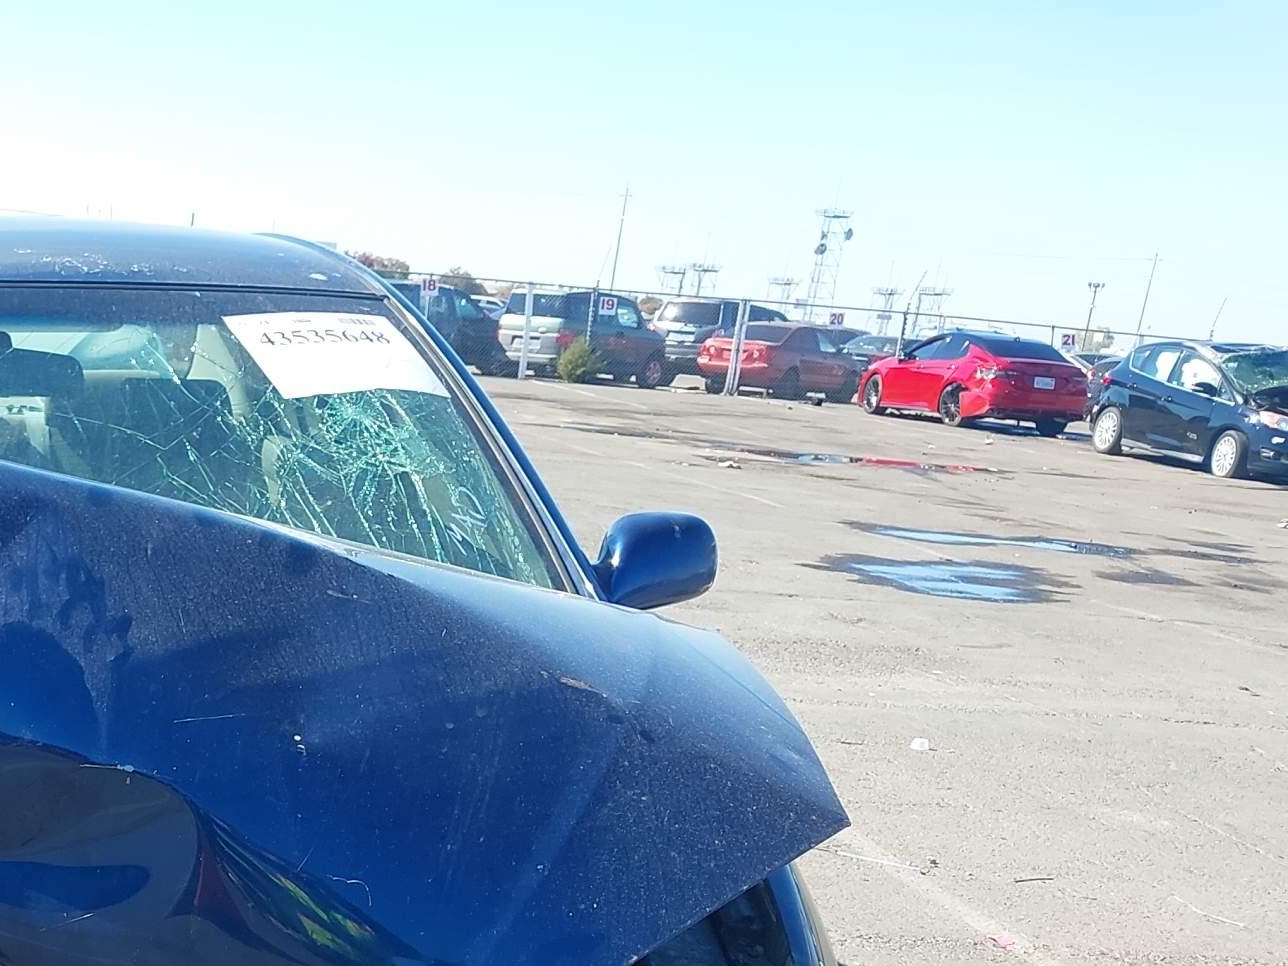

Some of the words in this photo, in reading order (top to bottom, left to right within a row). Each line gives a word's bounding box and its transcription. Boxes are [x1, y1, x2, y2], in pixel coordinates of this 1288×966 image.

[422, 280, 437, 292] 18
[601, 298, 615, 311] 19
[829, 313, 844, 325] 20
[261, 329, 390, 345] 43535648
[1062, 335, 1076, 347] 21
